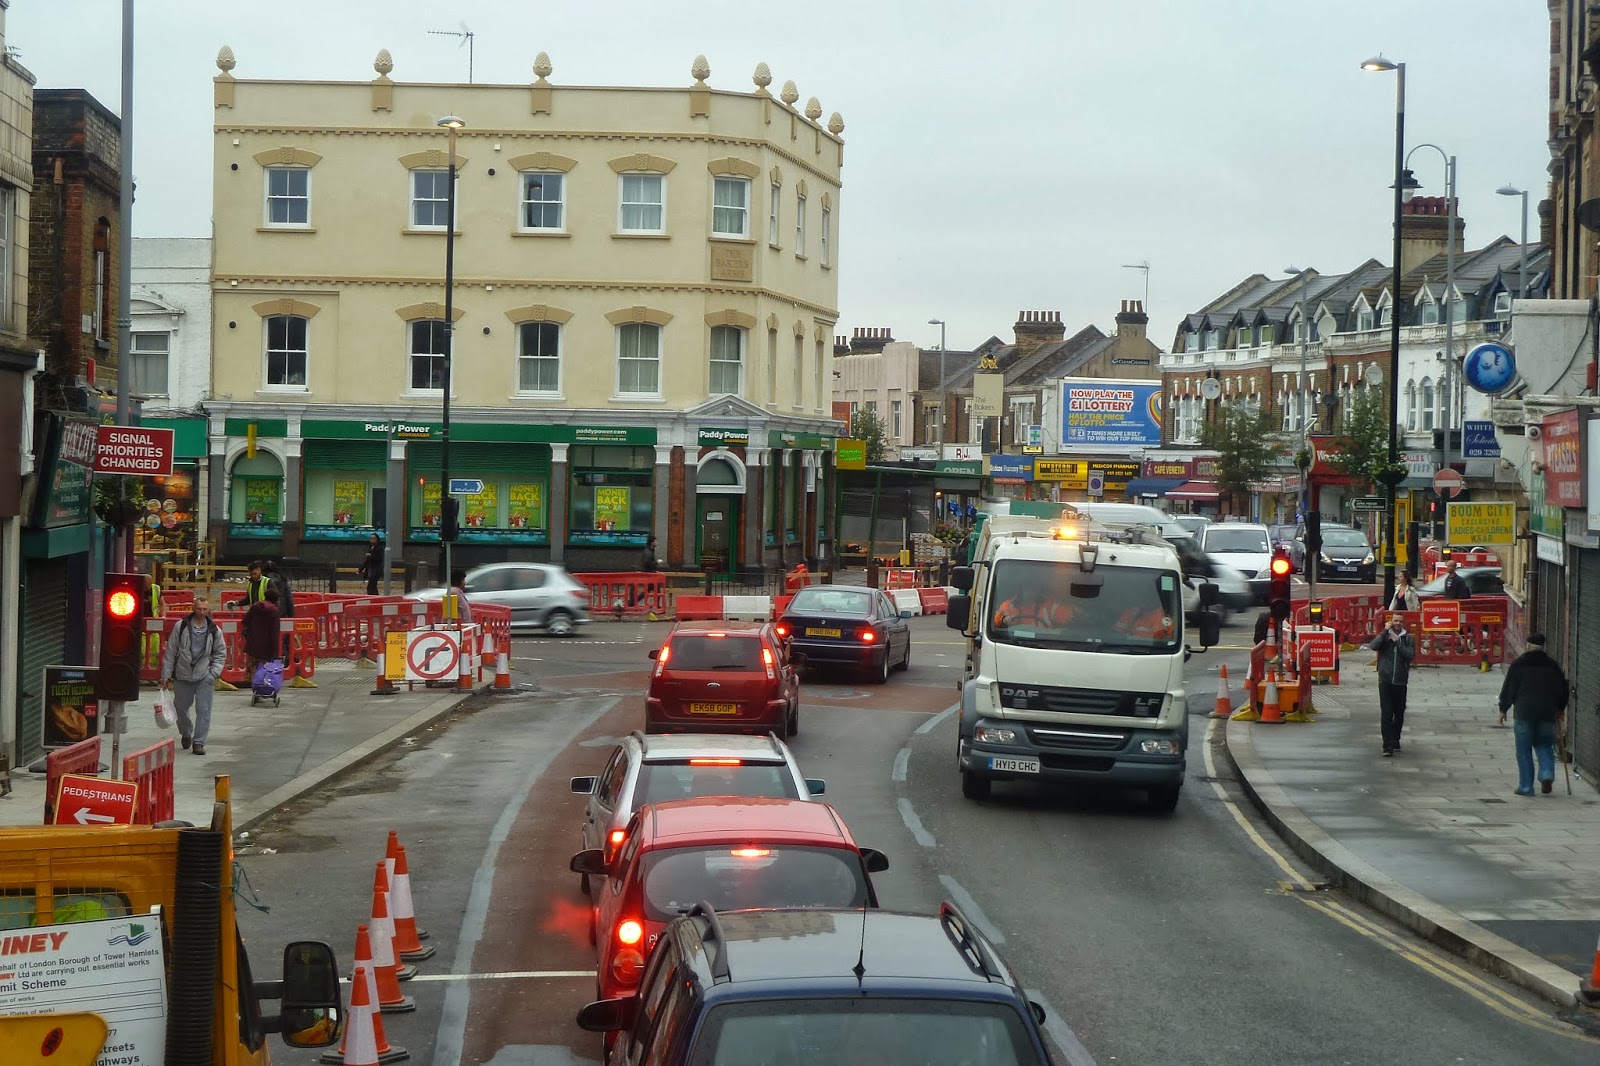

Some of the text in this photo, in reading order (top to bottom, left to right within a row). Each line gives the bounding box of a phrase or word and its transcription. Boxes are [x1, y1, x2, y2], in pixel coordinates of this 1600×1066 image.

[716, 259, 749, 268] BAKERS
[722, 269, 745, 278] ARMS
[1070, 389, 1133, 399] NOW PLAY THE
[1070, 400, 1133, 411] £1 LOTTERY
[397, 424, 430, 432] Power
[109, 432, 154, 445] SIGNAL
[700, 431, 748, 440] Paddy Power
[97, 445, 164, 458] PRIORITIES
[100, 457, 160, 470] CHANGED
[335, 481, 365, 489] MONEY
[510, 485, 539, 493] MONEY
[247, 488, 277, 497] BACK
[335, 488, 365, 497] BACK
[510, 492, 539, 501] BACK
[597, 488, 627, 496] MONEY
[597, 496, 627, 505] BACK
[1451, 504, 1511, 517] BOOM CITY
[1003, 688, 1039, 697] DAF
[1135, 697, 1160, 706] LF
[693, 704, 734, 713] EK58 GOP
[995, 760, 1037, 771] HY13 CHC
[63, 786, 132, 803] PEDESTRIANS
[29, 960, 57, 968] London
[59, 957, 90, 966] Borough
[93, 954, 101, 962] of
[104, 952, 126, 961] Tower
[128, 948, 160, 958] Hamlets
[18, 971, 30, 979] Ltd
[31, 970, 43, 978] are
[46, 967, 75, 977] carrying
[92, 961, 126, 971] essential
[128, 958, 151, 968] works
[22, 978, 67, 990] Scheme
[18, 995, 36, 1003] works
[38, 1006, 55, 1014] work)
